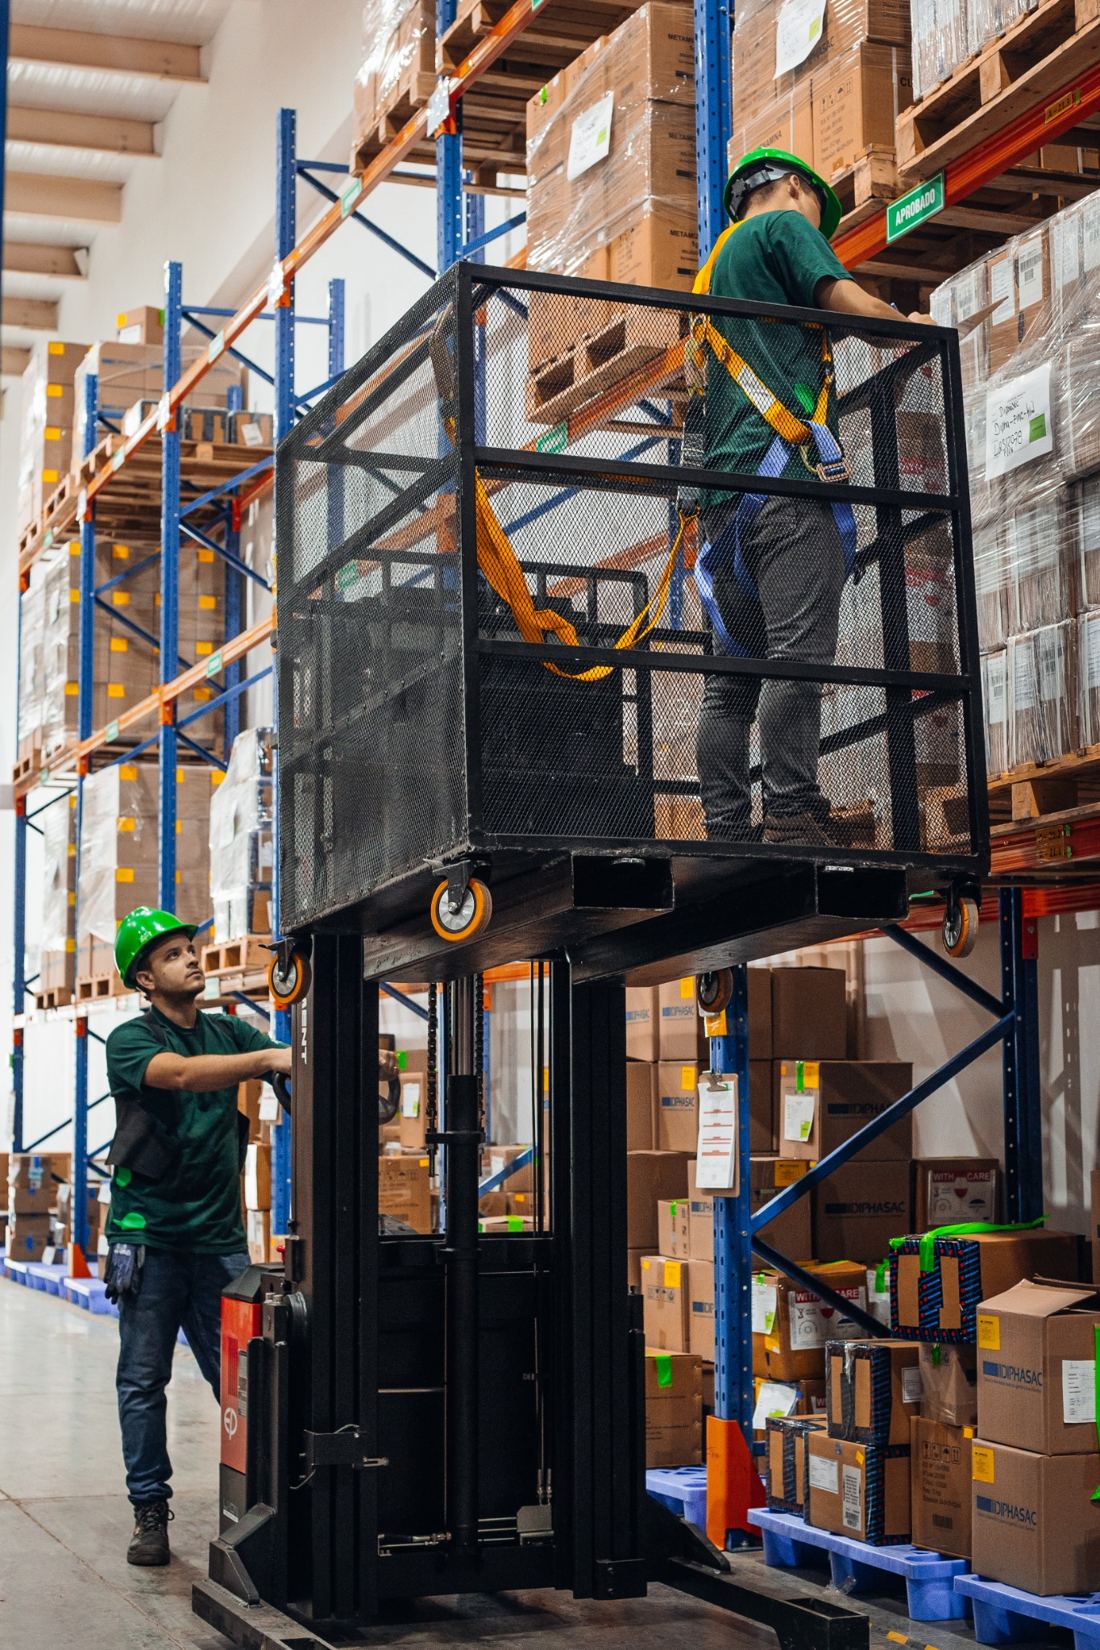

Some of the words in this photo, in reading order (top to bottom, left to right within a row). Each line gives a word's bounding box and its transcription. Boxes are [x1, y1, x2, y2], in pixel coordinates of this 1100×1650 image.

[895, 188, 936, 227] APROBADO
[933, 1171, 955, 1181] WITH
[966, 1170, 991, 1180] CARE
[1000, 1363, 1043, 1387] DIPHASAC
[993, 1500, 1037, 1526] DIPHASAC
